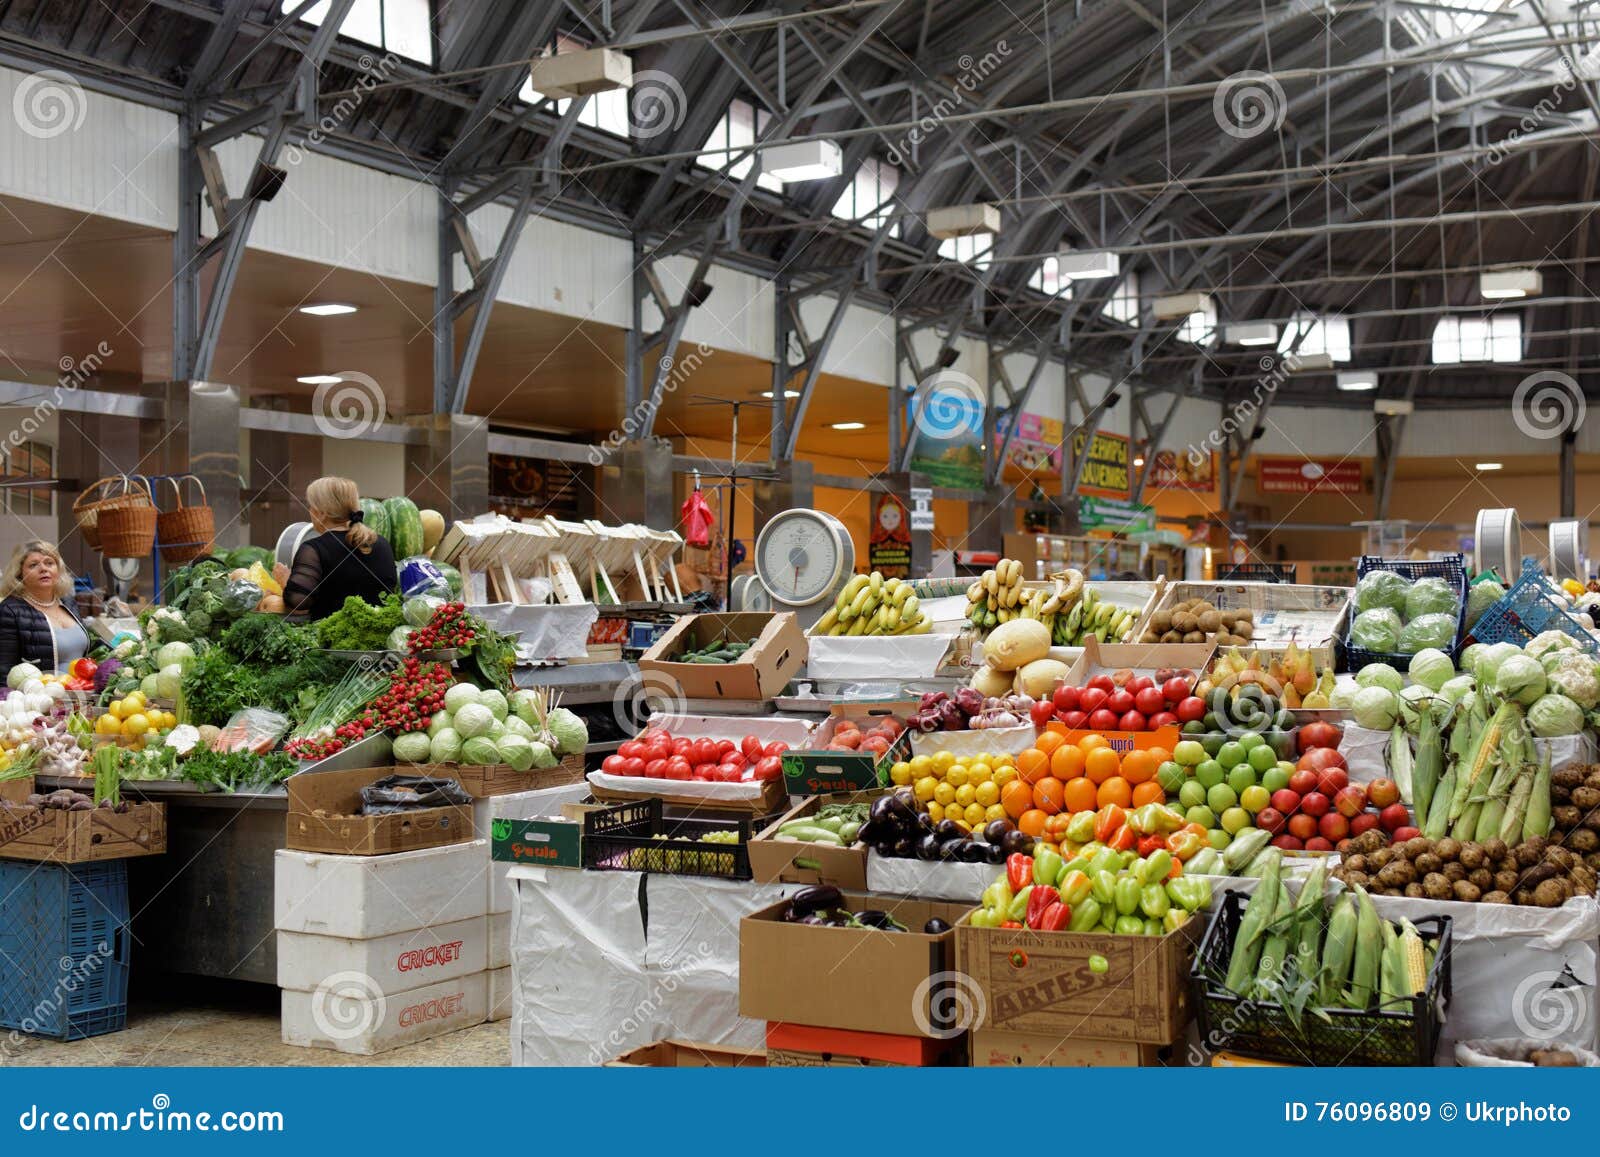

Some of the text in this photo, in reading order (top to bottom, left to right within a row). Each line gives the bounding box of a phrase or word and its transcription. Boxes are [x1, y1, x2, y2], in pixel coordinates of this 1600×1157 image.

[397, 940, 464, 972] CRICKET
[398, 992, 465, 1028] CRICKET
[994, 965, 1096, 1020] ARTES
